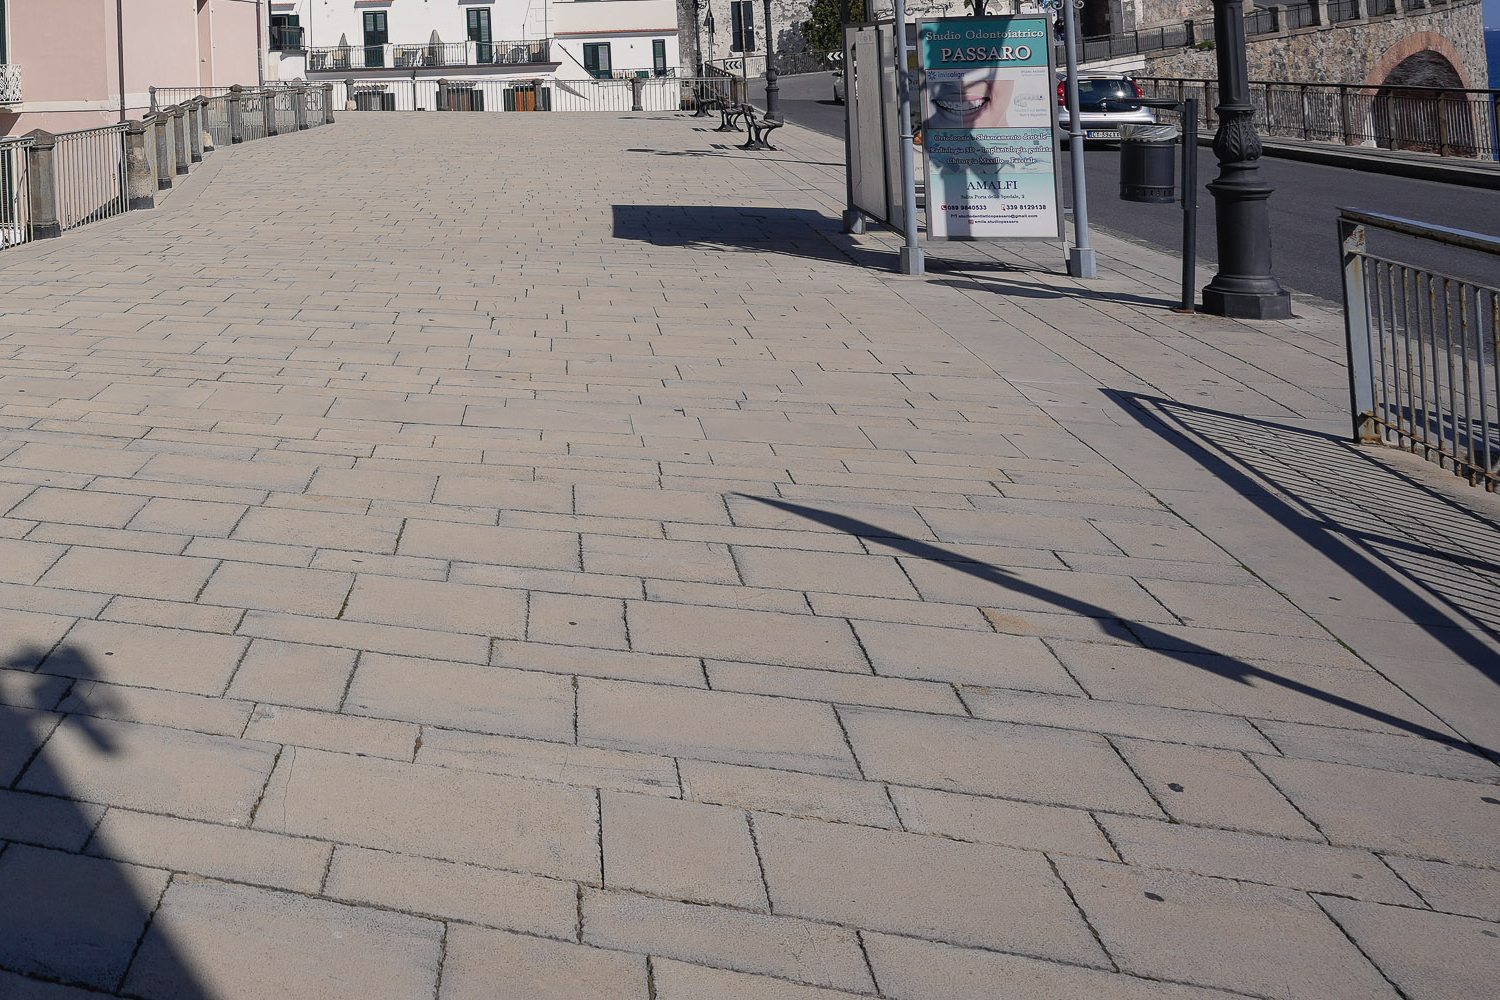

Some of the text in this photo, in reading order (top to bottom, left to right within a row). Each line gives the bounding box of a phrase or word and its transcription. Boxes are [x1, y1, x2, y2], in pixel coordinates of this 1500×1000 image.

[926, 29, 1044, 41] Studio Odontoiatrico
[940, 45, 1032, 62] PASSARO
[937, 71, 965, 79] invisalign
[976, 133, 1020, 141] Sbiancamento
[930, 147, 964, 155] Radiologia
[982, 146, 1027, 155] Implantologia
[1027, 145, 1052, 154] guidata
[947, 157, 978, 166] Chirurgia
[966, 180, 1018, 190] AMALFI
